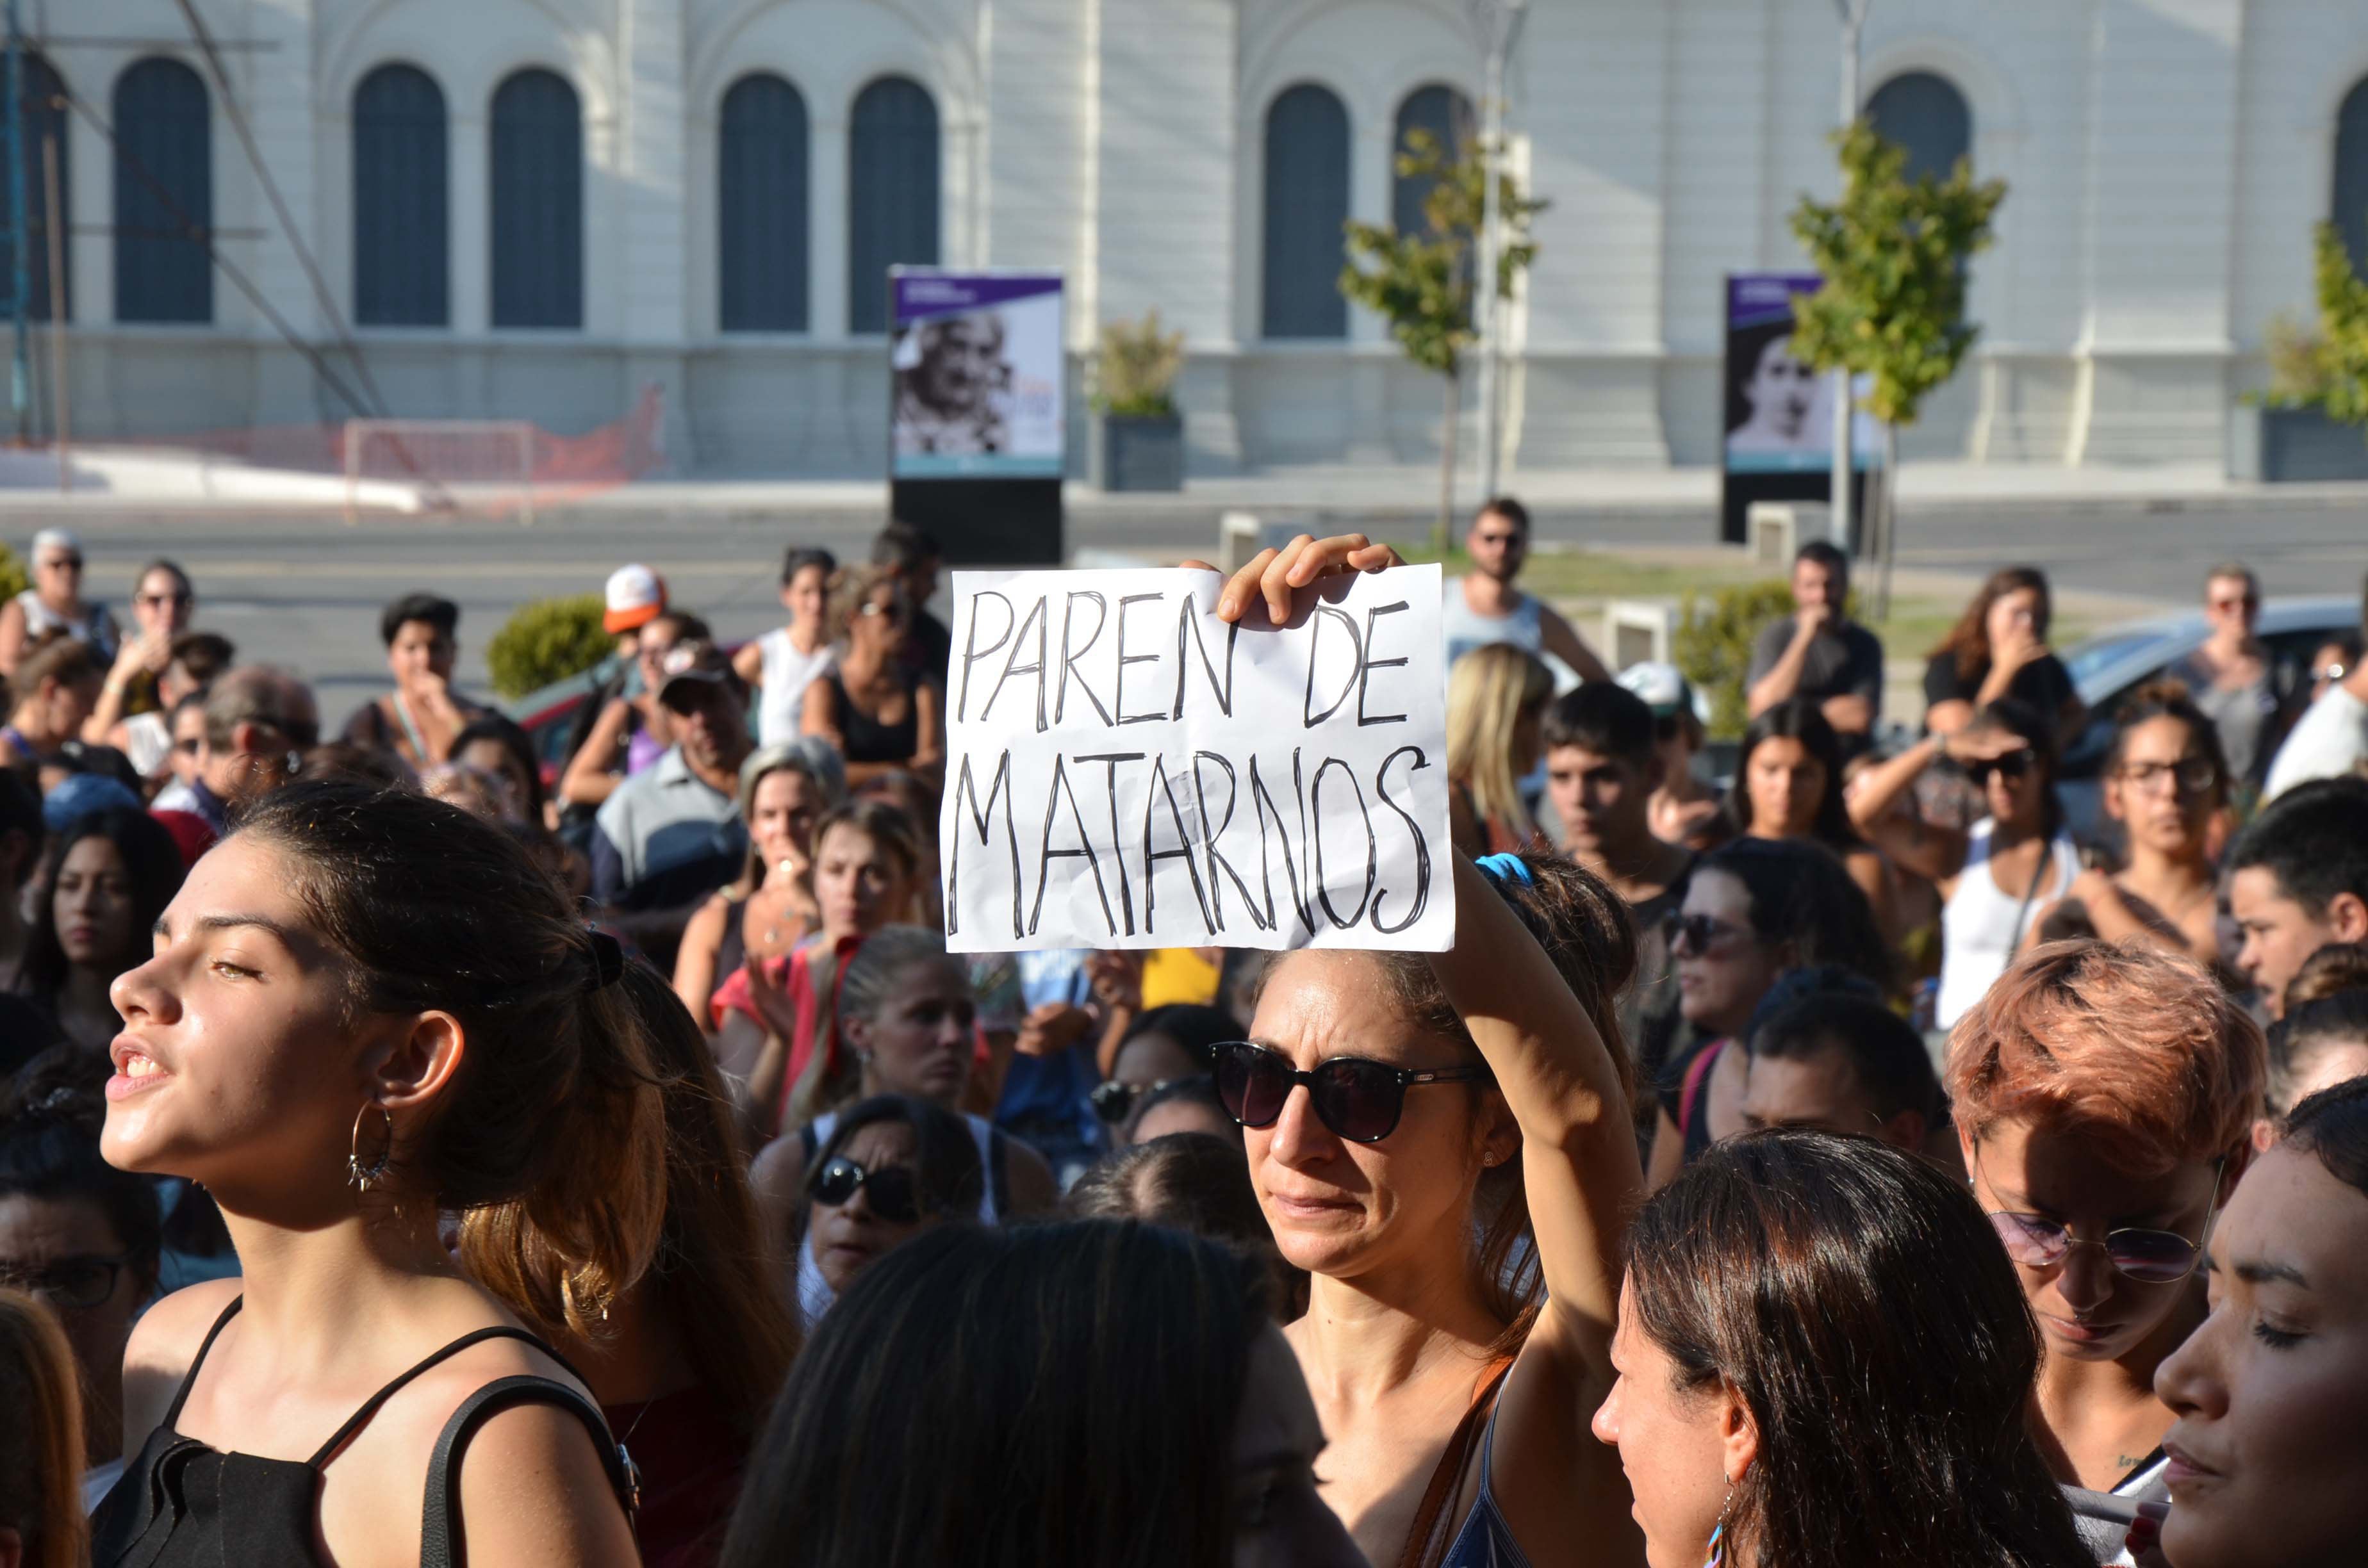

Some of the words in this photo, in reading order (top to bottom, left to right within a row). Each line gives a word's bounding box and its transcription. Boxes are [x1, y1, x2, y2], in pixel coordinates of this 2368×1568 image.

[958, 591, 1241, 733] PAREN
[1304, 600, 1410, 729] DE
[947, 746, 1431, 940] MATARNOS
